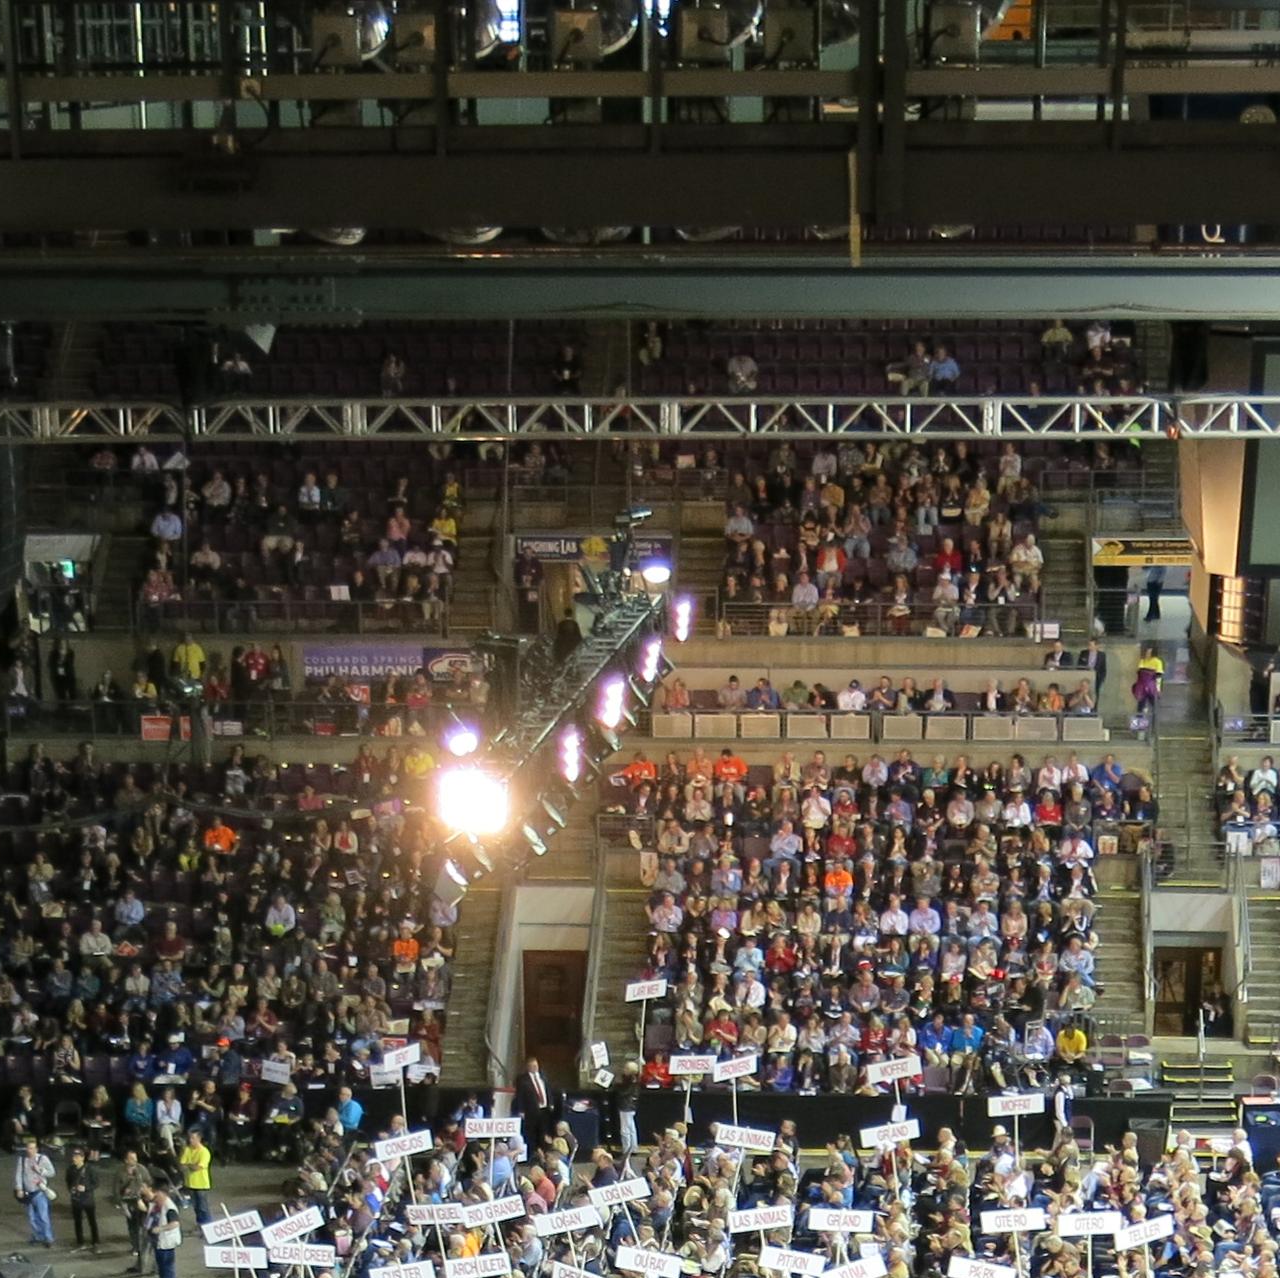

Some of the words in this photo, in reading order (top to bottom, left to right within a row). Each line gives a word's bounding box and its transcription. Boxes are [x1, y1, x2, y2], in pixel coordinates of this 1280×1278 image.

[304, 656, 367, 665] COLORADO
[467, 1121, 484, 1133] SAN
[484, 1121, 518, 1134] MIGUEL
[876, 1127, 910, 1142] GRAND
[384, 1134, 425, 1152] CONEJOS
[719, 1128, 733, 1141] LAS
[737, 1131, 772, 1147] ANIMAS
[599, 1184, 634, 1203] LOGAN
[409, 1207, 426, 1221] SAN
[467, 1209, 483, 1224] RIO
[485, 1198, 523, 1219] GRANDE
[732, 1214, 751, 1229] LAS
[753, 1210, 788, 1226] ANIMAS
[214, 1214, 258, 1239] COSTILLA
[272, 1213, 315, 1241] HINSDALE
[551, 1211, 582, 1230] LOGAN
[826, 1213, 861, 1228] GRAND
[994, 1214, 1028, 1228] OTERO
[1128, 1222, 1161, 1242] TELLER
[271, 1246, 300, 1260] CLEAR
[302, 1247, 334, 1264] CREEK
[633, 1254, 667, 1272] OURAY
[776, 1254, 810, 1271] PITKIN
[452, 1258, 507, 1277] ARCHULETA
